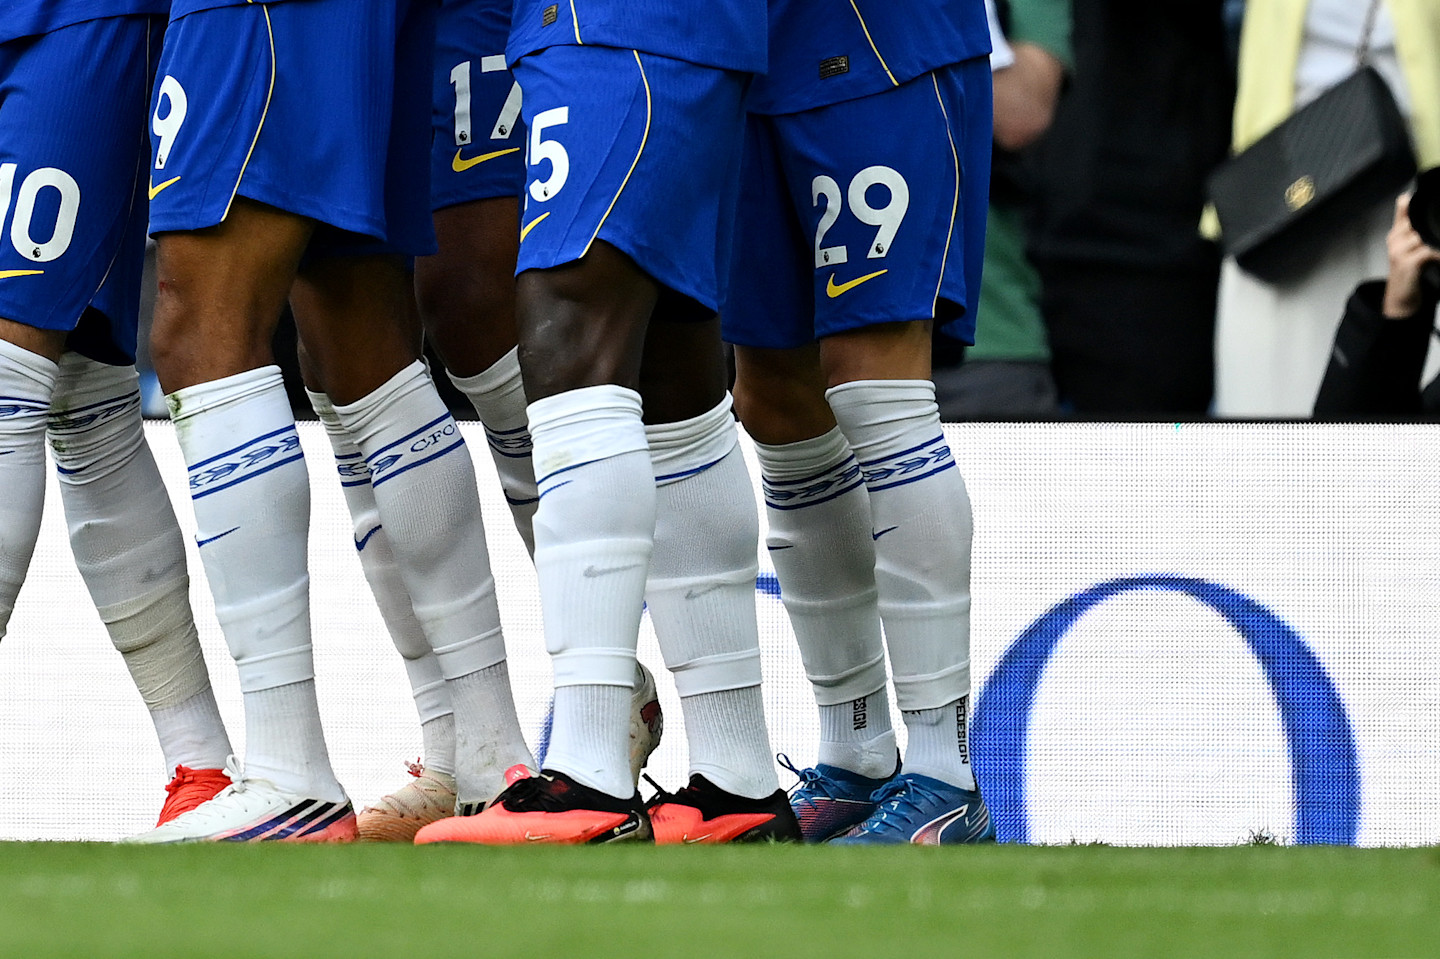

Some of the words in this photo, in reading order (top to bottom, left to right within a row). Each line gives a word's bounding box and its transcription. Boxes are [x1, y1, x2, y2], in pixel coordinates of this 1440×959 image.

[449, 54, 523, 146] 17
[812, 165, 910, 269] 29
[411, 424, 455, 452] CFC
